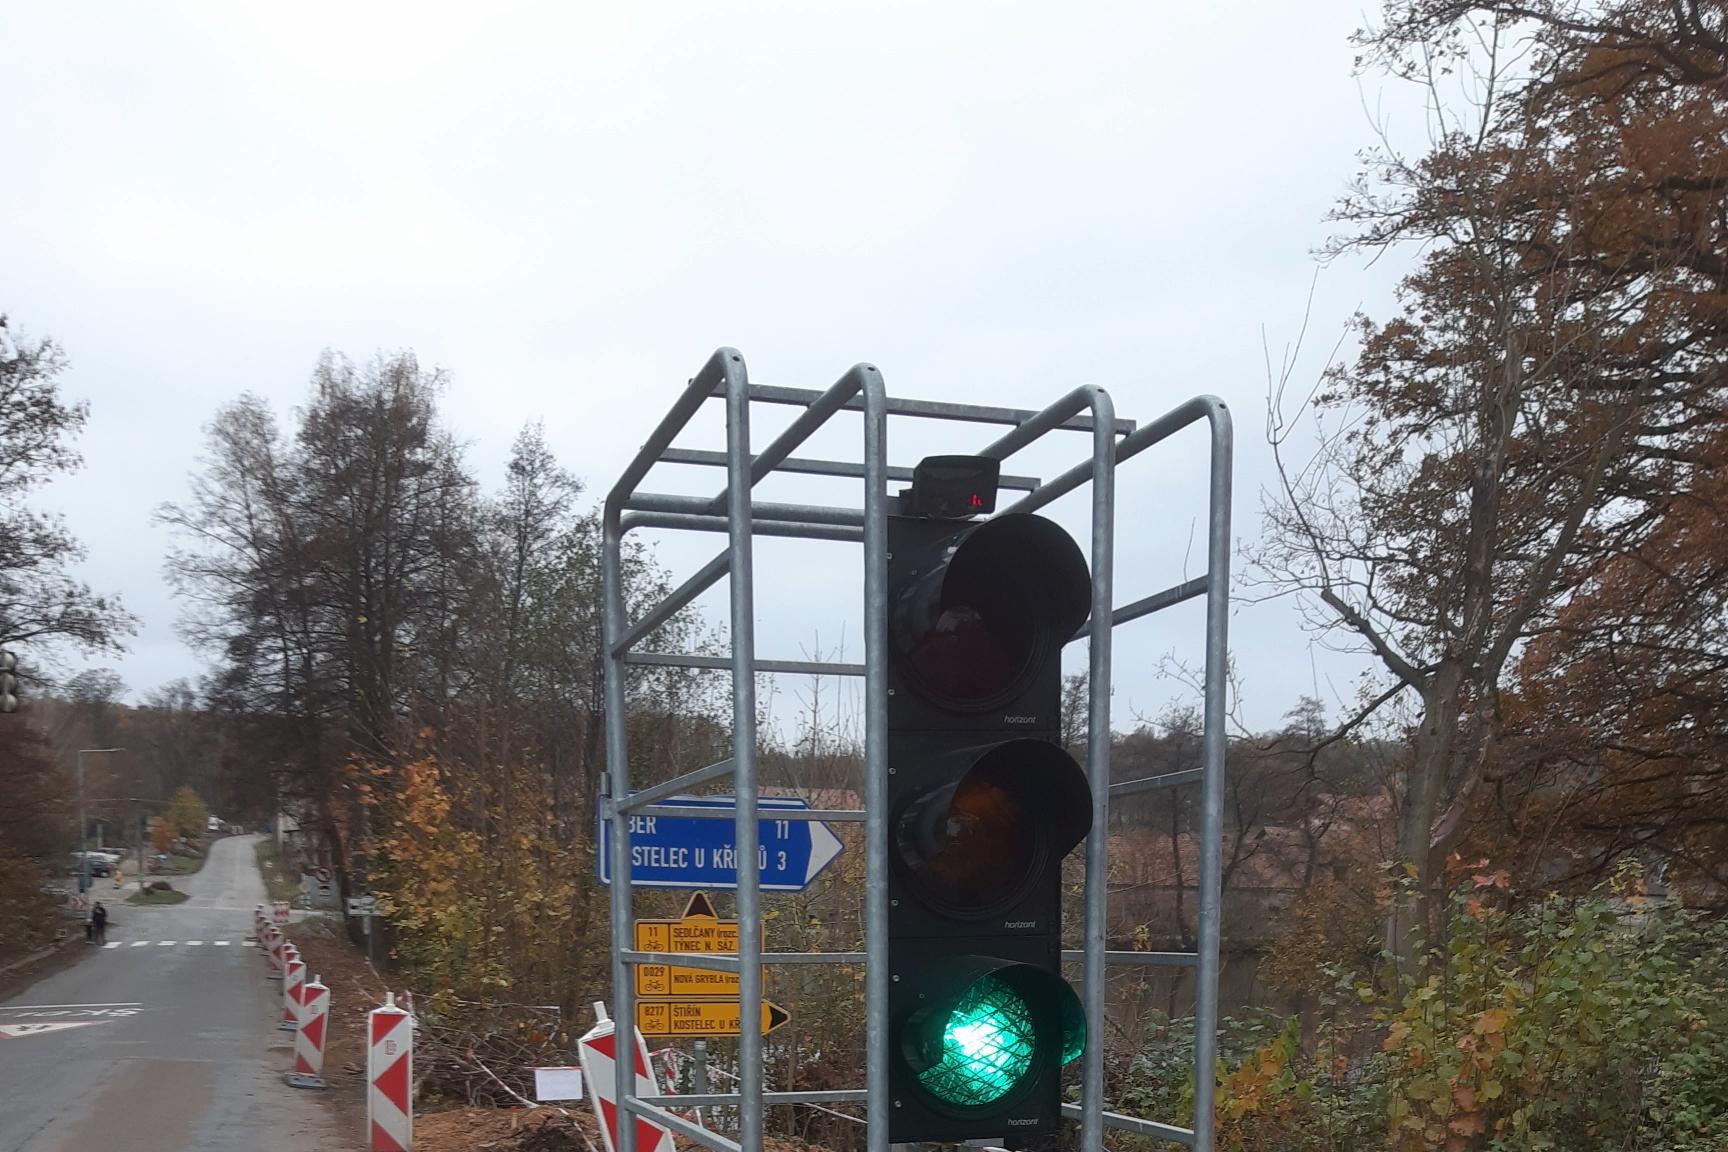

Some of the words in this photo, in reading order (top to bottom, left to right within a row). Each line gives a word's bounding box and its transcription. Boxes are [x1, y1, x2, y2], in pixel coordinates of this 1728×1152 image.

[775, 820, 789, 840] 11
[631, 846, 689, 869] STELEC
[695, 847, 705, 868] U
[777, 850, 787, 871] 3
[648, 926, 658, 937] 11
[673, 925, 716, 938] SEDLČANY
[672, 938, 701, 951] TÝNEC
[672, 972, 692, 984] NOVÁ
[644, 1006, 665, 1016] 8217
[673, 1004, 701, 1016] ŠTIŘÍN
[673, 1019, 715, 1030] KOSTELEC
[719, 1020, 726, 1030] U
